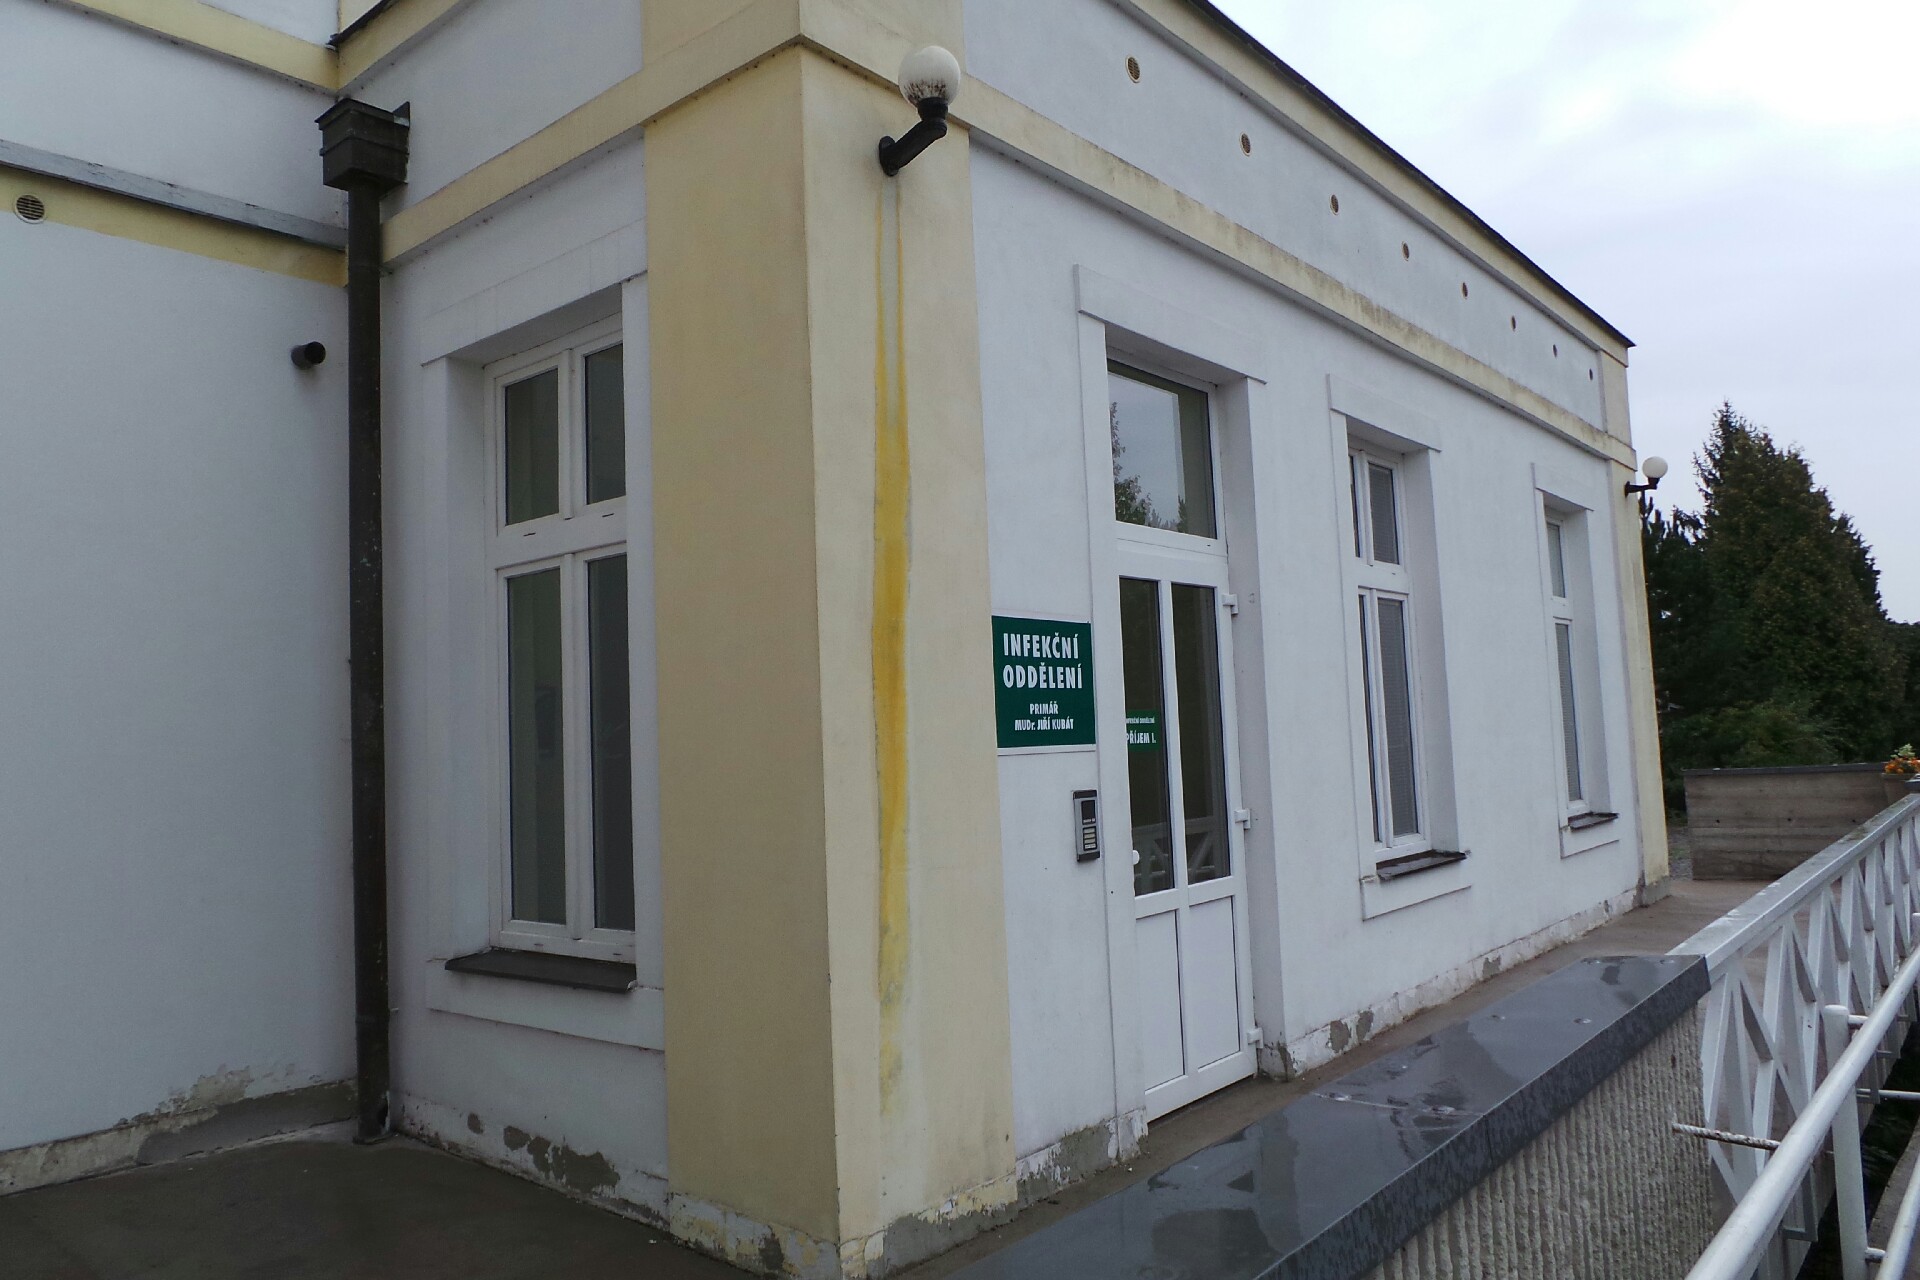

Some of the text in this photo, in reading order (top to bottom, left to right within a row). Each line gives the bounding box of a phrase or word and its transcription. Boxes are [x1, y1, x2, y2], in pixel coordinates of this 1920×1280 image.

[1003, 632, 1079, 659] INFEKČNÍ
[1003, 662, 1083, 689] ODDĚLENÍ
[1029, 700, 1059, 715] PRIMÁŘ
[1014, 715, 1074, 731] MUDr. JIŘÍ KUBÁT
